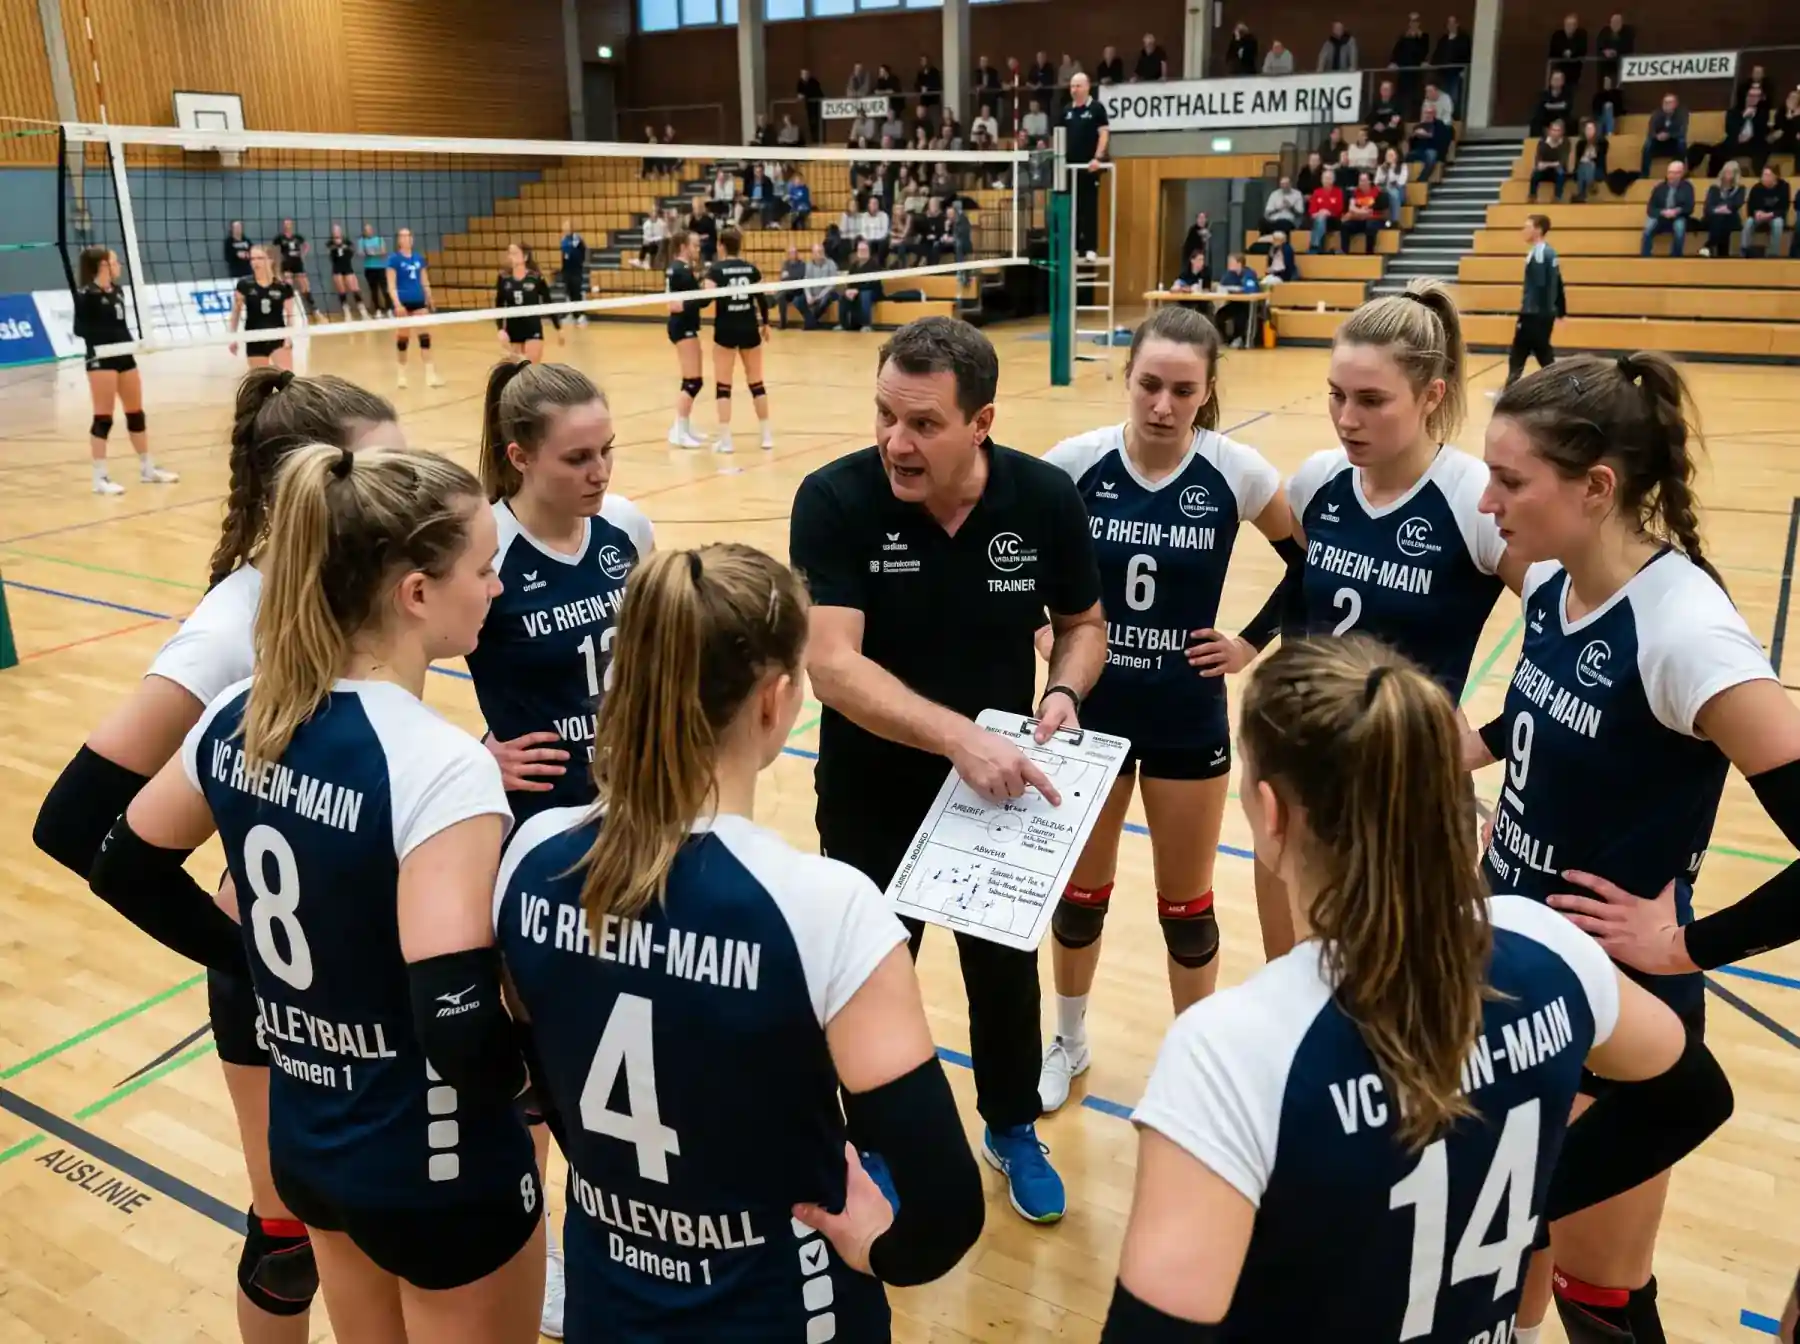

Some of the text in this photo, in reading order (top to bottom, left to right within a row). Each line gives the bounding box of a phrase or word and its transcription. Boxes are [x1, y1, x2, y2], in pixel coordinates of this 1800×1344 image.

[1626, 56, 1730, 77] ZUSCHAUER
[1108, 86, 1352, 119] SPORTHALLE AM RING
[1185, 491, 1206, 505] VC
[995, 540, 1019, 555] VC
[1106, 518, 1216, 550] RHEIN-MAIN
[1405, 524, 1428, 541] VC
[602, 551, 621, 566] VC
[1125, 553, 1158, 611] 6
[1320, 546, 1433, 595] RHEIN-MAIN
[987, 578, 1036, 592] TRAINER
[522, 586, 627, 639] VC RHEIN-M
[1332, 587, 1362, 638] 2
[1155, 655, 1163, 670] 1
[1586, 646, 1607, 670] VC
[1513, 658, 1602, 739] RHEIN-MAIN
[211, 738, 232, 782] VC
[1509, 711, 1535, 791] 9
[1513, 867, 1521, 887] 1
[243, 824, 313, 991] 8
[521, 892, 549, 944] VC
[269, 1042, 353, 1091] Damen 1
[579, 992, 681, 1184] 4
[1328, 1074, 1388, 1135] VC
[34, 1149, 152, 1215] AUSLINIE
[520, 1172, 536, 1213] 8
[570, 1162, 765, 1250] VOLLEYBALL
[1389, 1097, 1541, 1343] 14
[609, 1232, 713, 1286] Damen 1
